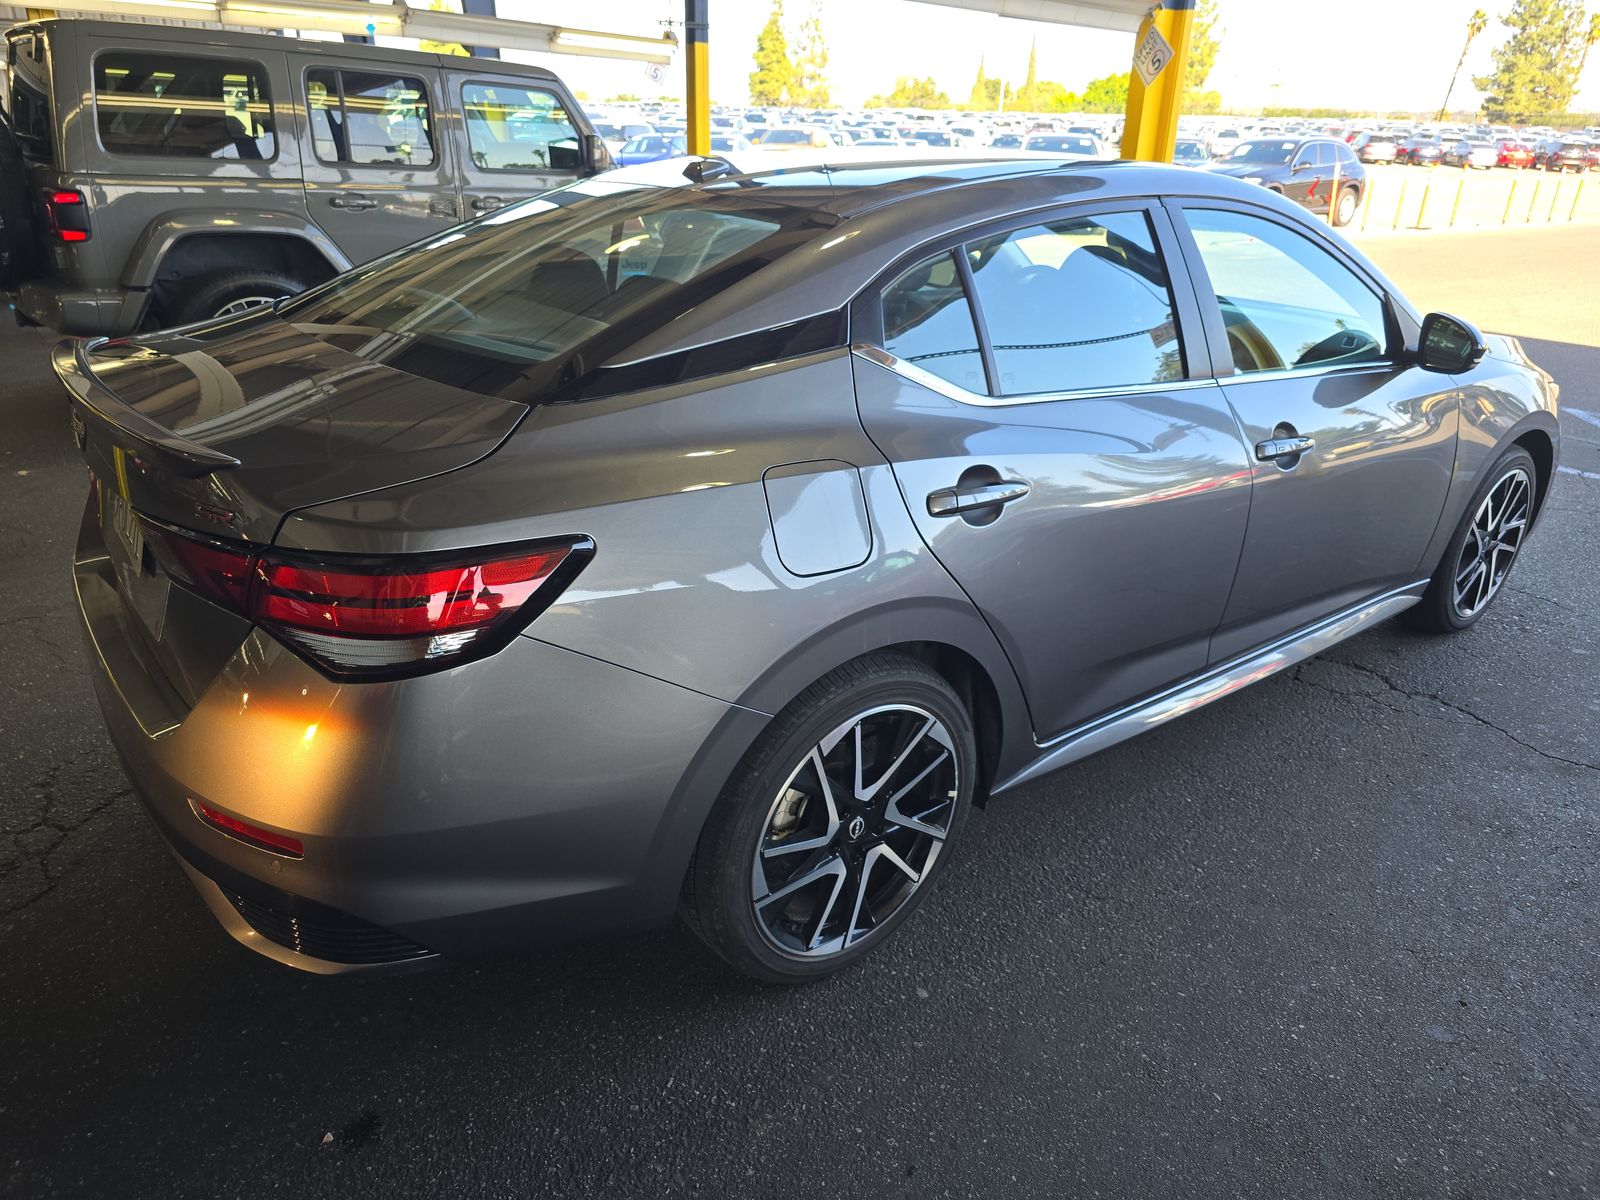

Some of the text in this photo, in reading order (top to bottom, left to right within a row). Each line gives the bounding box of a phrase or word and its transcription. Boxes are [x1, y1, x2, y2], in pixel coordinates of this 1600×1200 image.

[1136, 31, 1155, 61] SPEED
[1140, 38, 1159, 65] LIMIT
[651, 67, 661, 79] 5
[1151, 54, 1162, 71] 5
